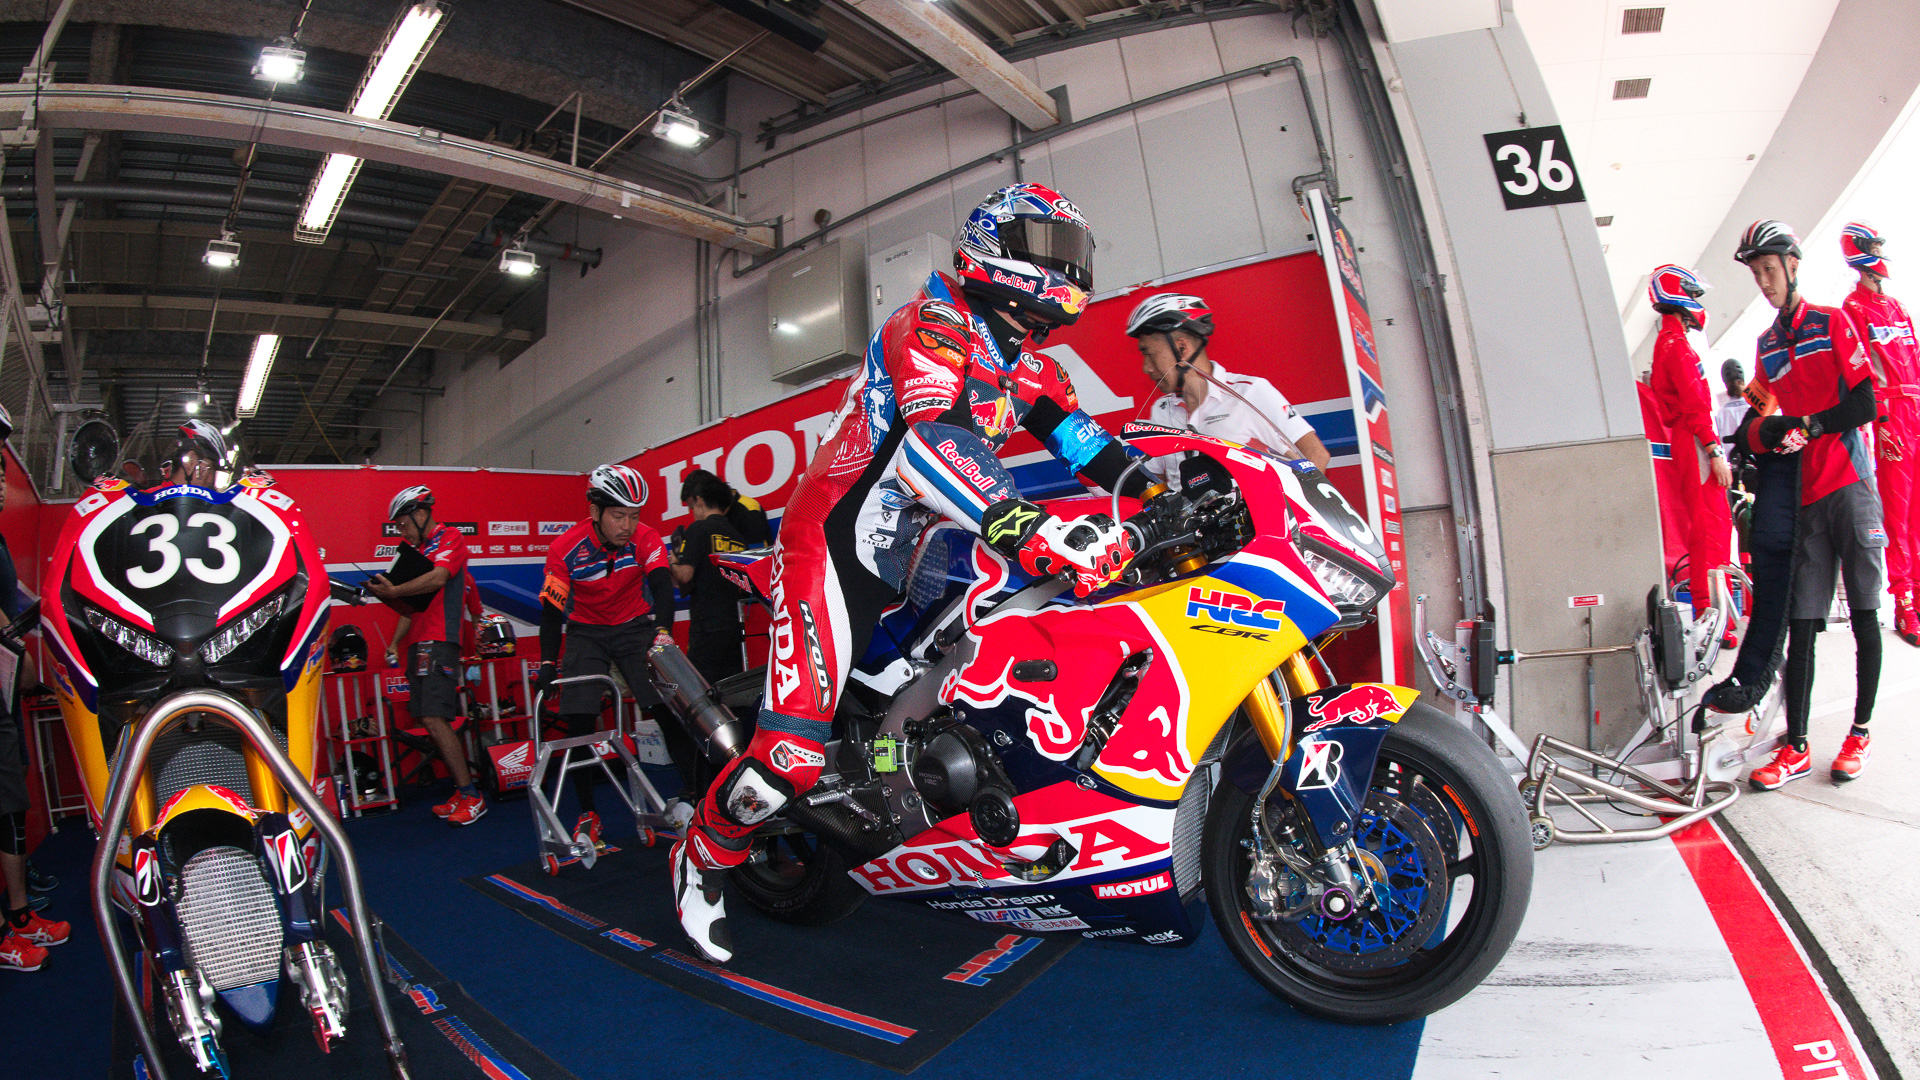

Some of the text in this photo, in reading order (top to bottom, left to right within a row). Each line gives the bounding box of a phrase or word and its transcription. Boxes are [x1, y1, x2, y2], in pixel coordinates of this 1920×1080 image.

[1496, 140, 1574, 195] 36
[993, 270, 1037, 294] Red Bull
[978, 322, 1005, 368] HONDA
[904, 377, 958, 393] HONDA
[1125, 423, 1152, 433] Red
[937, 439, 997, 491] Red Bull
[154, 485, 214, 501] HONDA
[126, 512, 241, 589] 33
[862, 539, 889, 548] OAKLEY
[1186, 586, 1286, 630] HRC
[1189, 624, 1269, 640] CBR
[801, 603, 828, 688] HYOD
[500, 765, 533, 776] HOND
[1099, 876, 1169, 897] MOTUL
[926, 894, 1055, 910] Honda Dream
[1039, 904, 1070, 914] RK
[1090, 926, 1135, 937] YUTAKA
[1142, 930, 1179, 942] NGK
